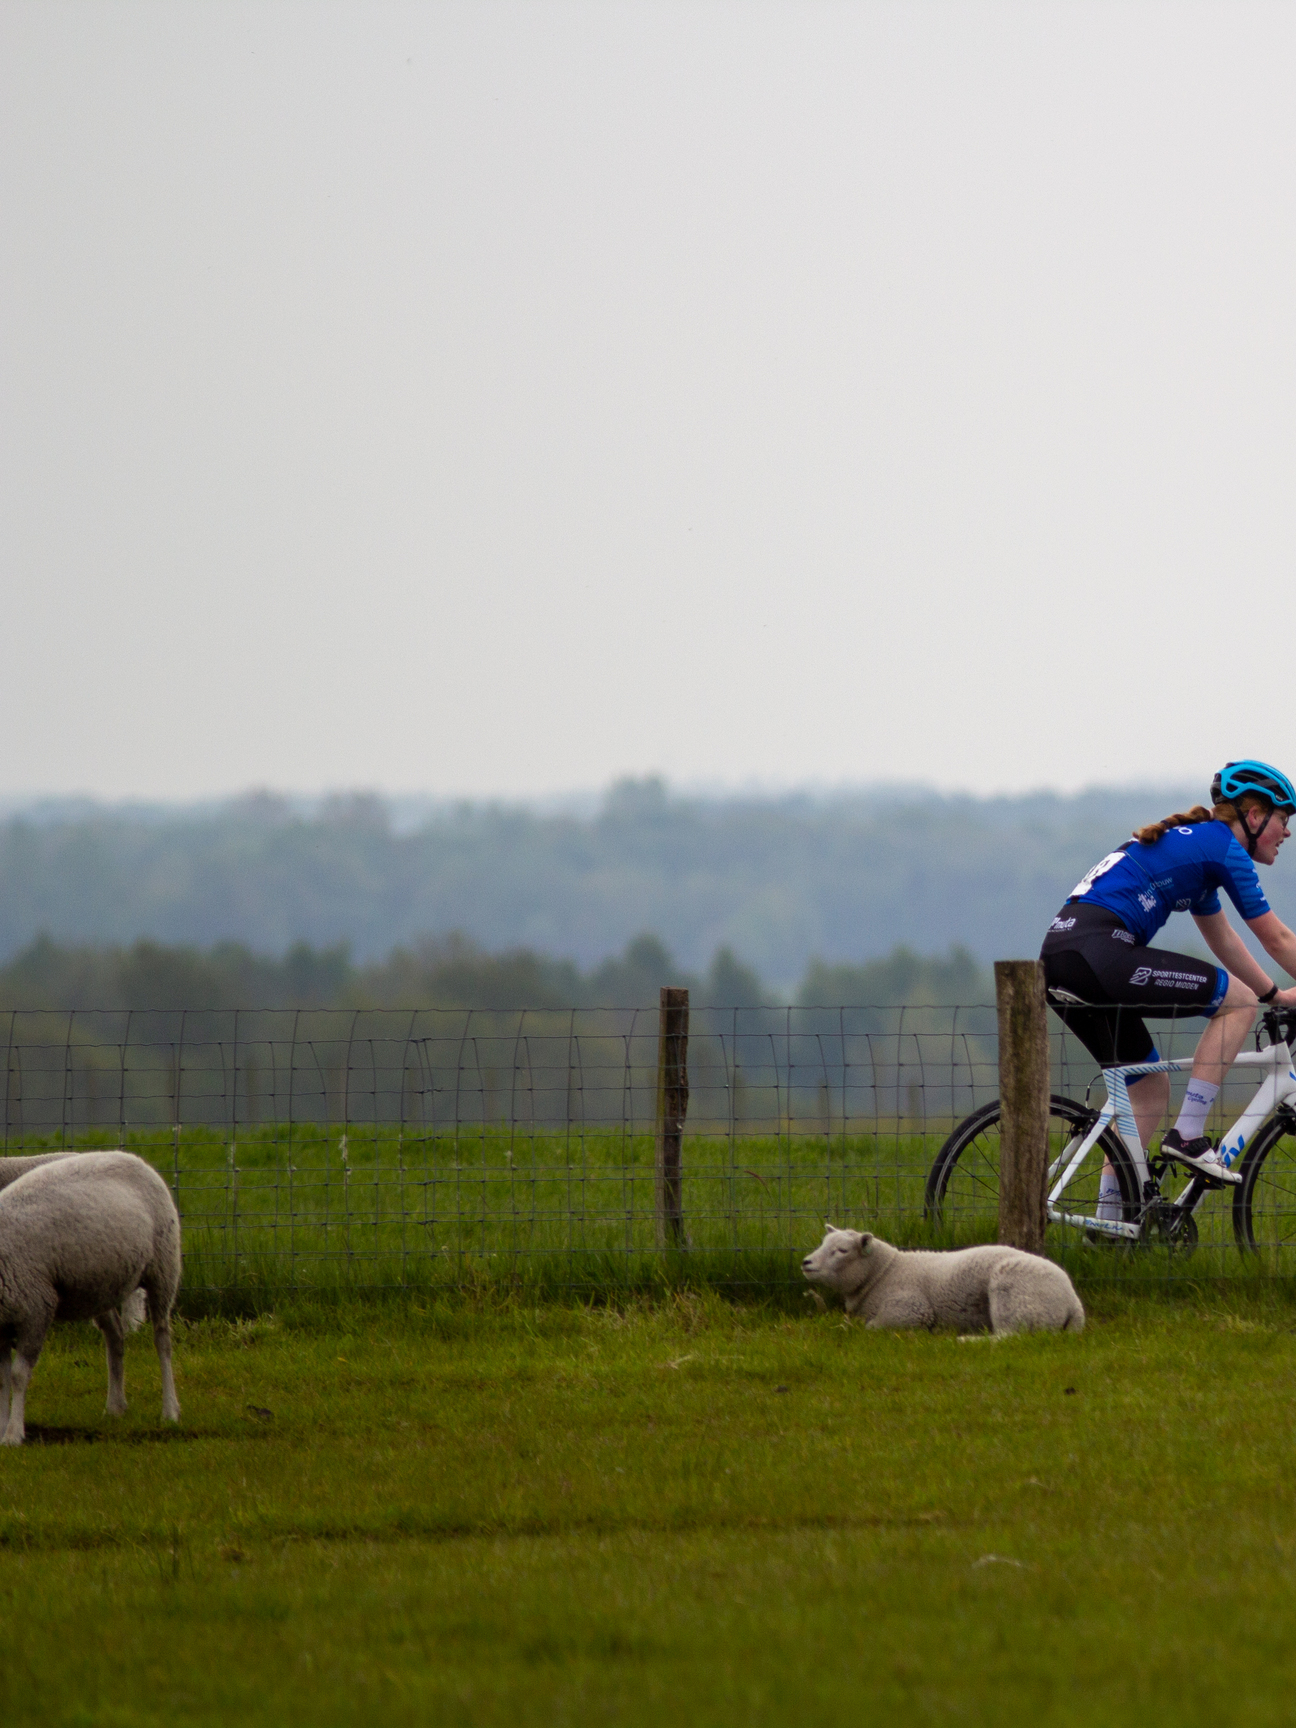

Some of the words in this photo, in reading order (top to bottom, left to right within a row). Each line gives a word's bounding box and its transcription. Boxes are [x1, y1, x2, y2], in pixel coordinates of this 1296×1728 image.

[1152, 970, 1208, 983] SPORTTESTCENTER
[1154, 978, 1175, 988] REGIO
[1174, 981, 1199, 991] MIDDEN
